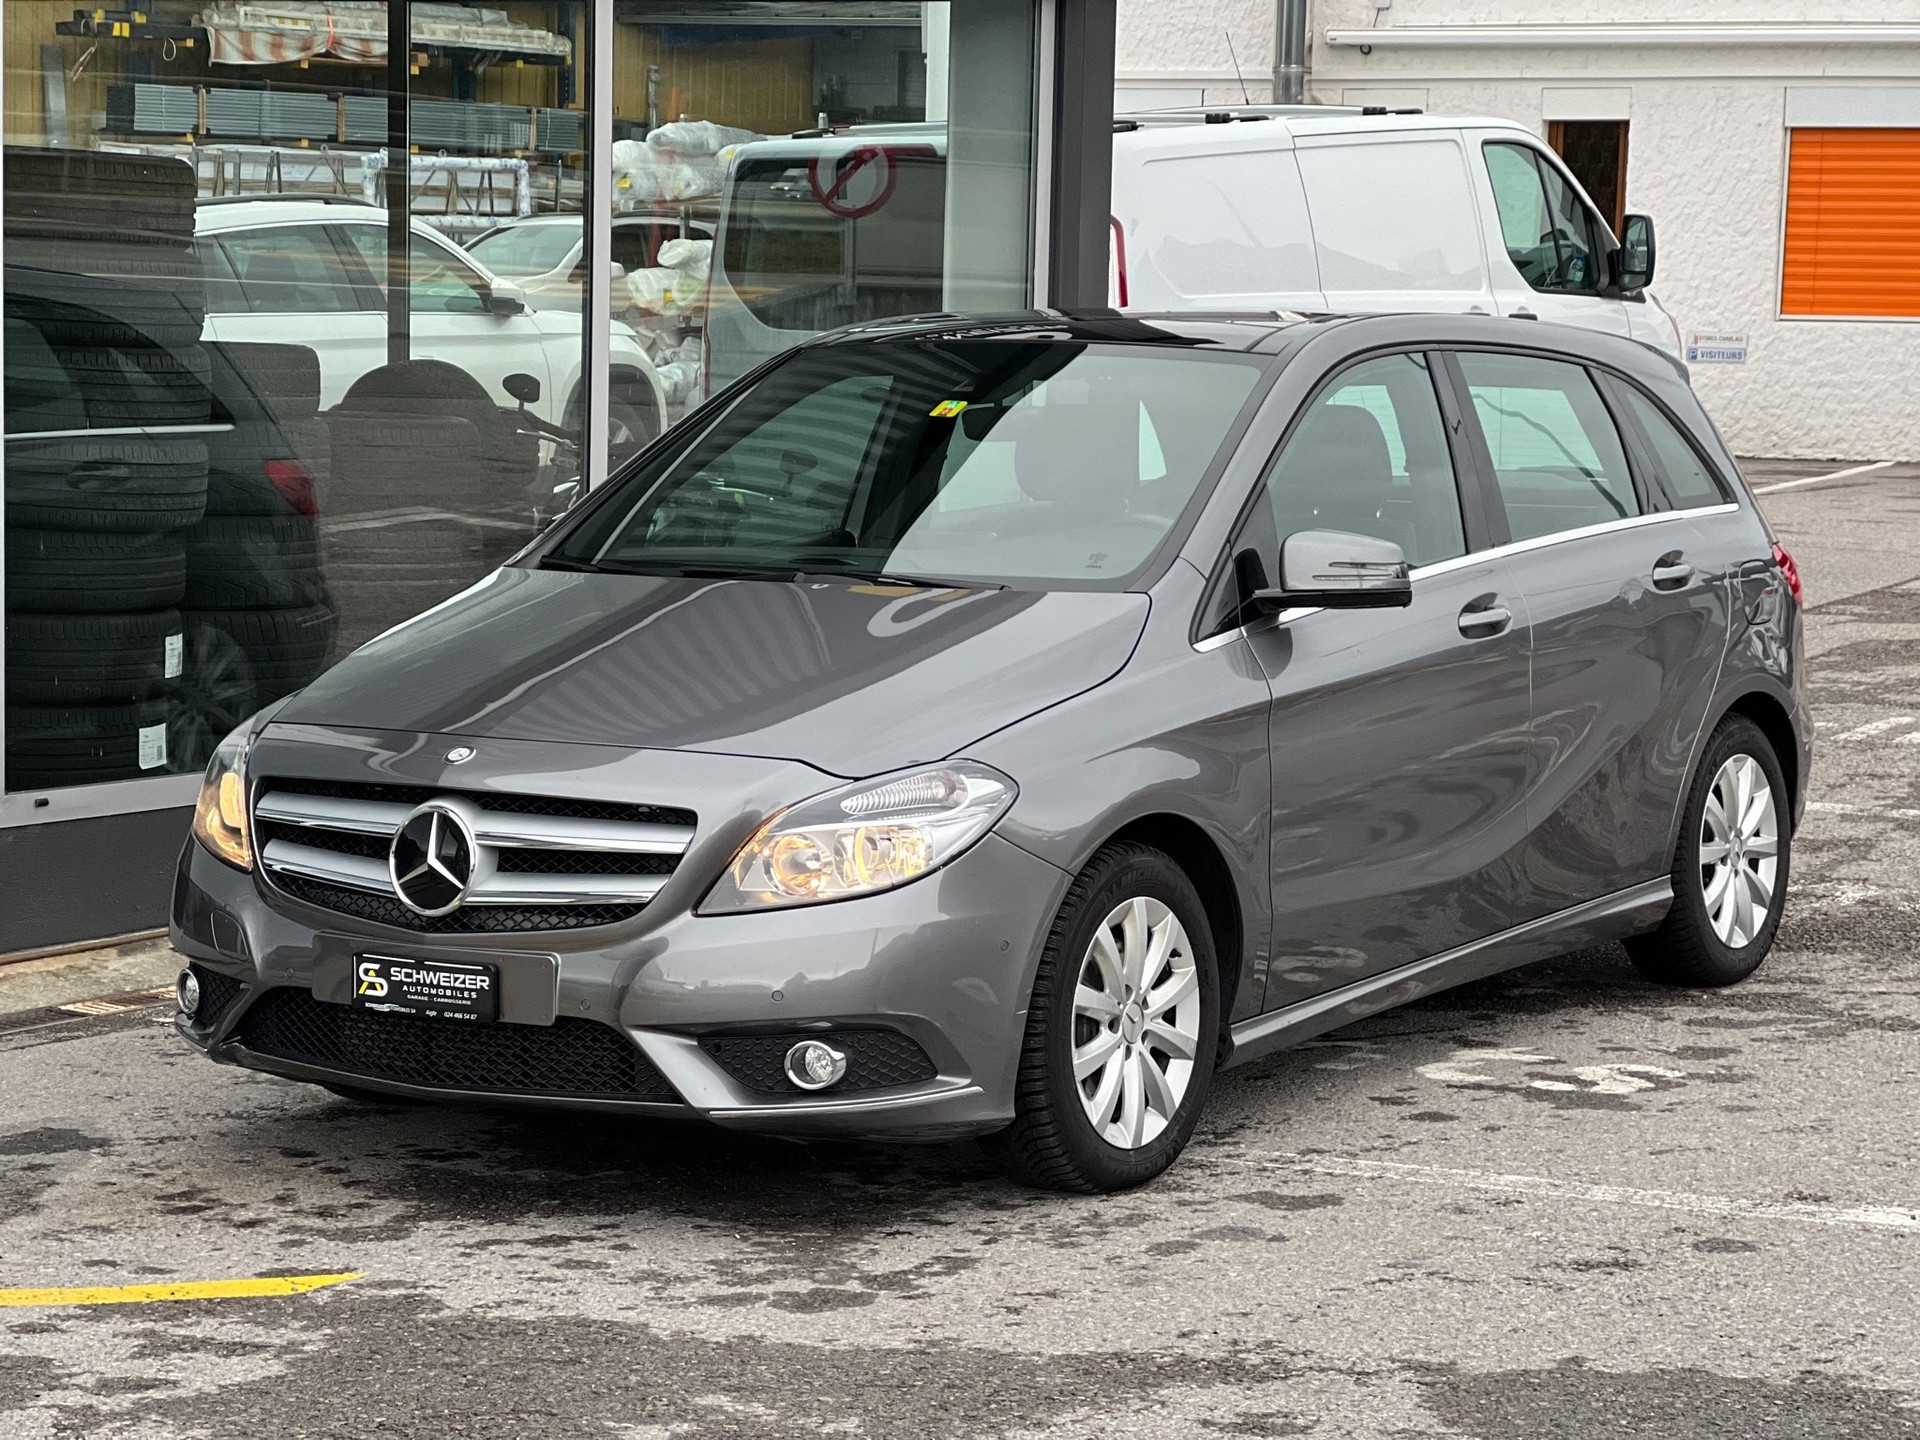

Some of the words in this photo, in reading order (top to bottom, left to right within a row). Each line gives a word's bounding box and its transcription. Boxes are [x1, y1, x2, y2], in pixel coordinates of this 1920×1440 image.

[1700, 350, 1743, 360] VISITEURS
[390, 966, 490, 990] SCHWEIZER
[402, 984, 478, 999] AUTOMOBILES
[433, 997, 472, 1005] CARROSSERIE
[425, 1009, 438, 1017] Aigle
